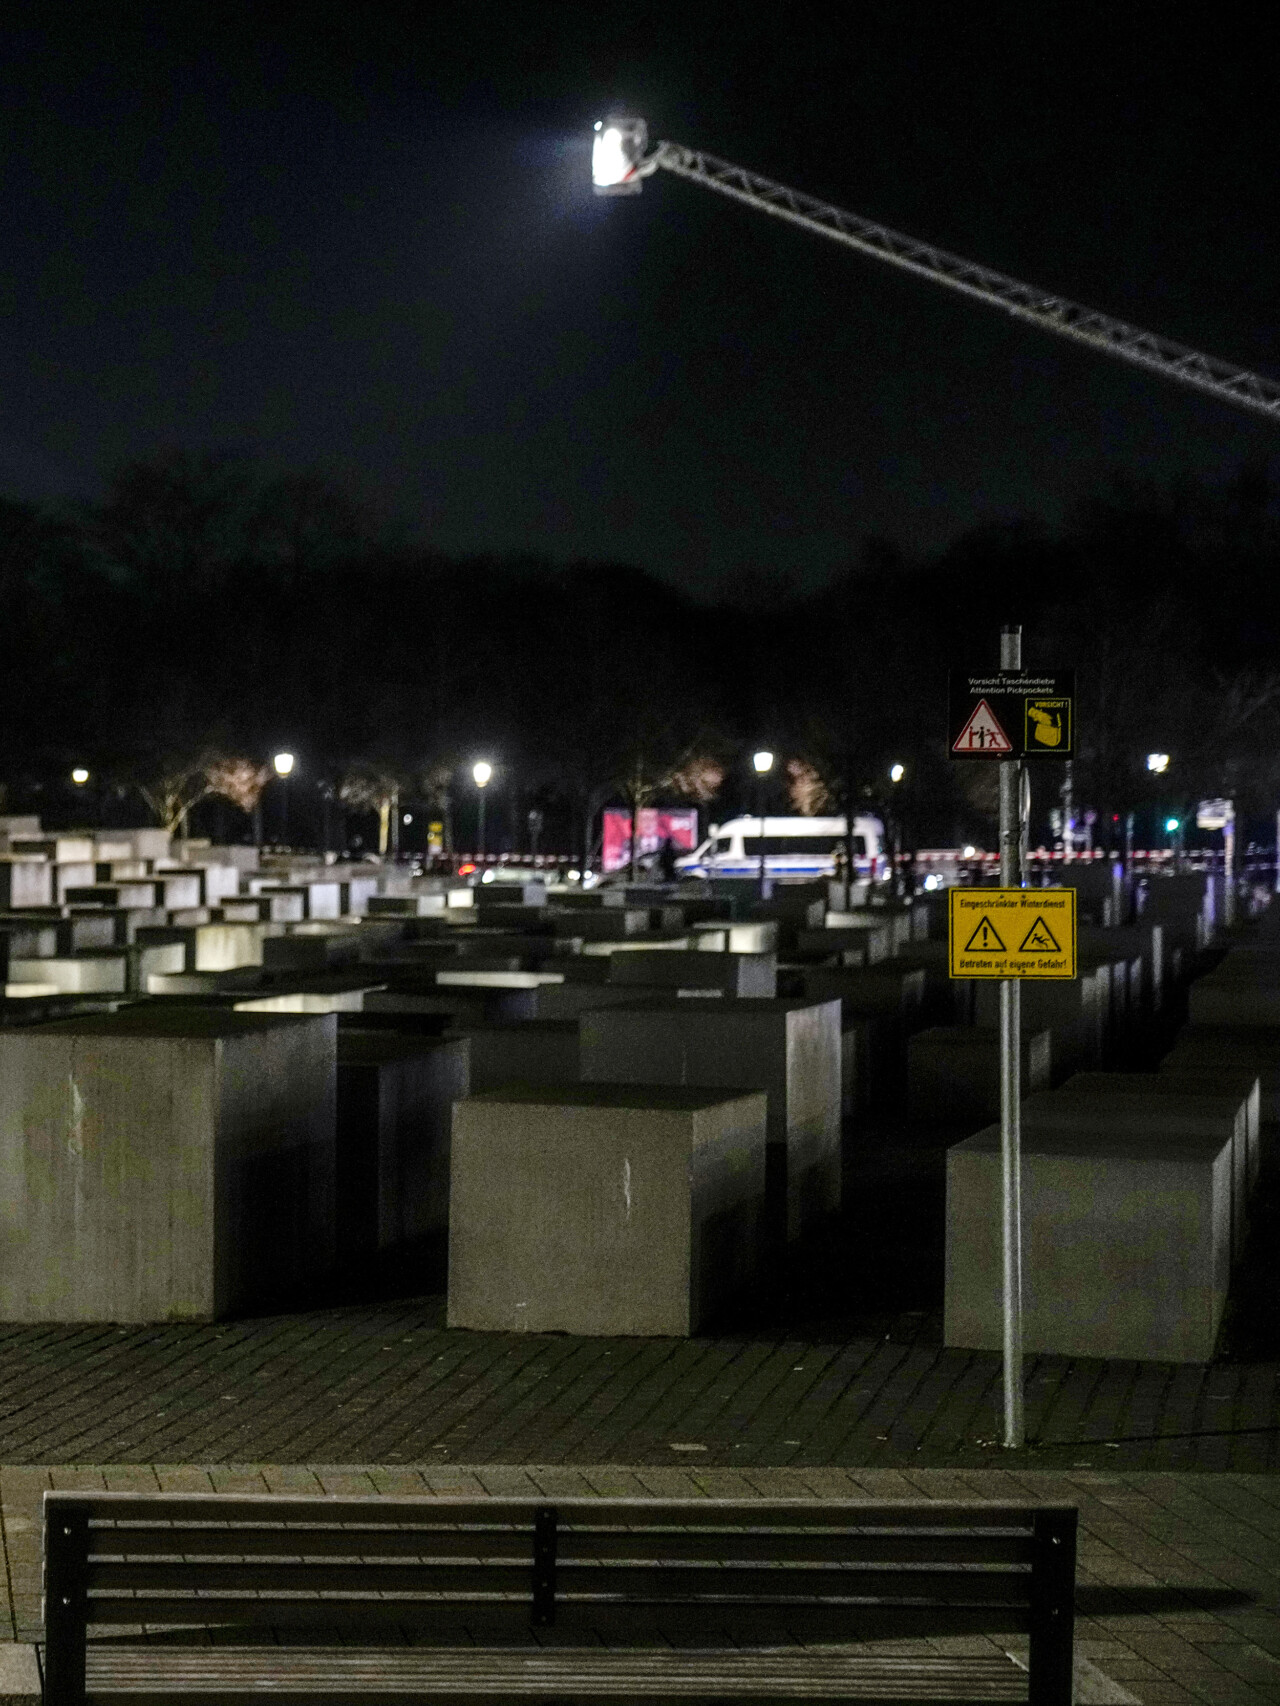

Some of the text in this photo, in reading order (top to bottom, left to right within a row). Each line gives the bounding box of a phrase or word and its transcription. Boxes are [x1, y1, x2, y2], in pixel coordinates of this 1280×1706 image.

[968, 677, 1056, 685] Vorsicht Taschendiebe
[969, 686, 1054, 695] Attention Pickpockets
[1020, 899, 1065, 908] Winterdienst
[960, 959, 1067, 971] Betreten auf eigene Gefahr!
